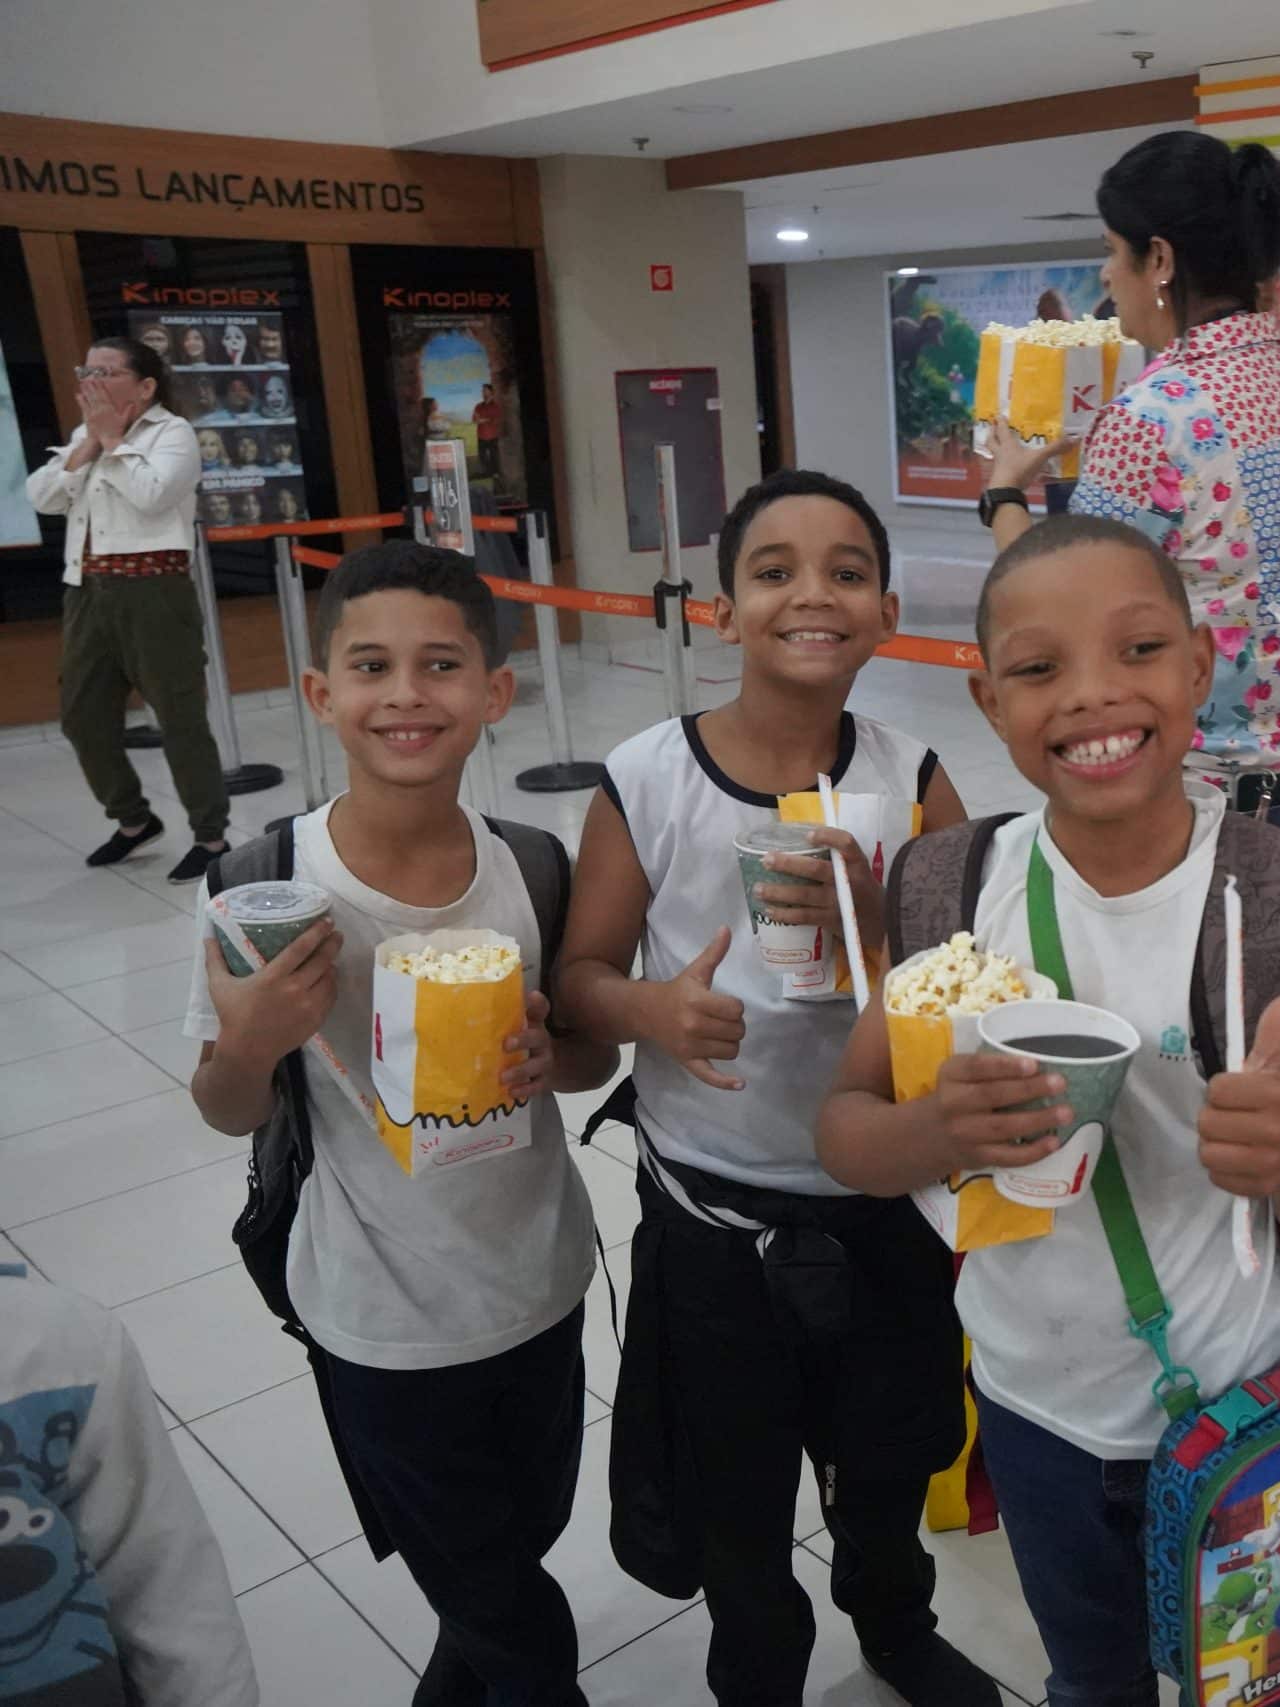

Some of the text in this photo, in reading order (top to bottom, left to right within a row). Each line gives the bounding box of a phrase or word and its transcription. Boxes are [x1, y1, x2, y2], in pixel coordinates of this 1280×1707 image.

[136, 167, 425, 214] LANÇAMENTOS
[121, 281, 280, 307] Kinoplex
[383, 286, 512, 310] Kinoplex
